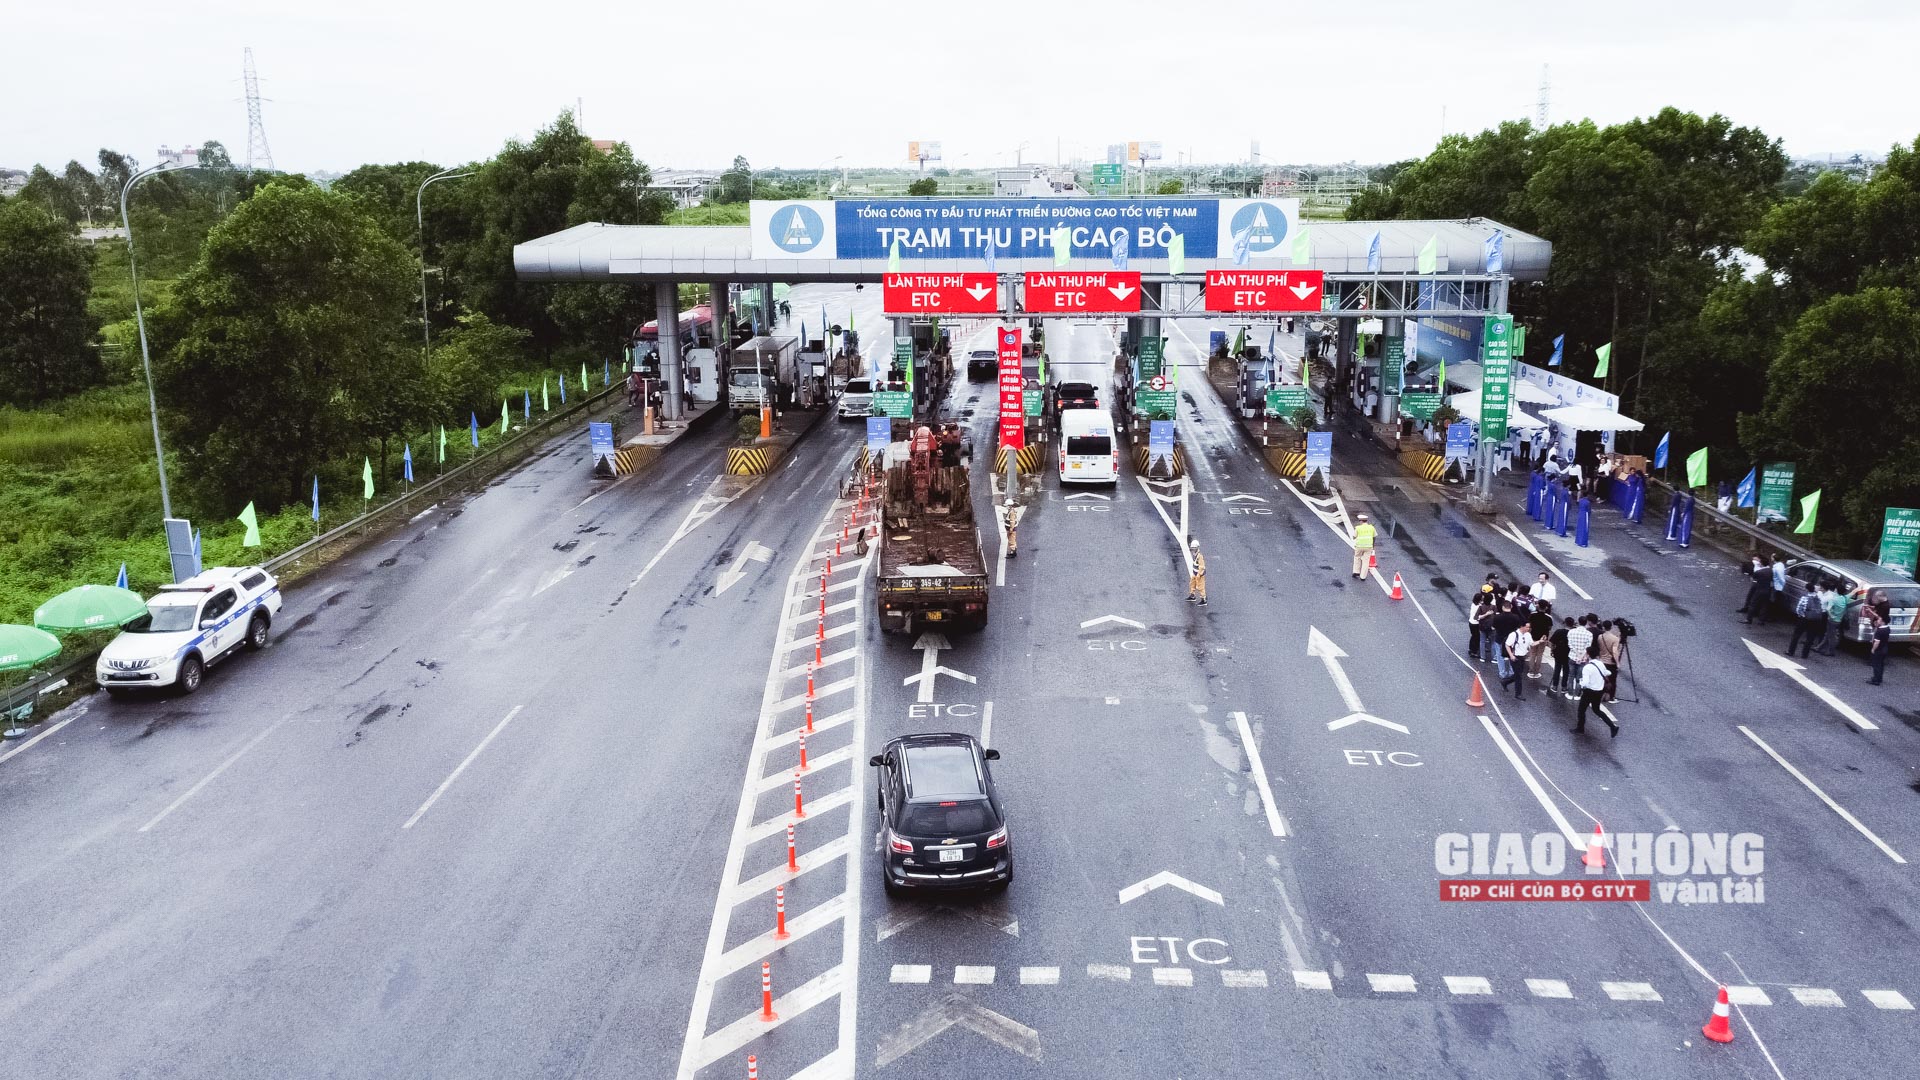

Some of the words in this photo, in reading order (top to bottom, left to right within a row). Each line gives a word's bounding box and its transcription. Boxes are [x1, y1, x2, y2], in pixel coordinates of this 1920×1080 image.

[857, 204, 887, 218] TỔNG
[890, 207, 922, 218] CÔNG
[925, 208, 938, 218] TY
[941, 205, 964, 218] ĐẦU
[967, 208, 982, 218] TƯ
[984, 206, 1013, 218] PHÁT
[1016, 204, 1049, 218] TRIỂN
[1052, 205, 1091, 218] ĐƯỜNG
[1094, 208, 1117, 218] CAO
[1120, 205, 1143, 218] TỐC
[1145, 207, 1170, 219] VIỆT
[1173, 208, 1197, 218] NAM
[877, 228, 950, 253] TRẠM
[959, 227, 1012, 248] THU
[888, 273, 914, 288] LÀN
[916, 276, 940, 288] THU
[943, 273, 964, 288] PHÍ
[1030, 273, 1055, 288] LÀN
[1058, 276, 1083, 288] THU
[1085, 273, 1107, 288] PHÍ
[1210, 272, 1236, 286] LÀN
[1238, 275, 1264, 286] THU
[1266, 272, 1289, 286] PHÍ
[911, 292, 941, 307] ETC
[1054, 292, 1086, 306] ETC
[1234, 291, 1267, 306] ETC
[1228, 507, 1273, 515] ETC
[1902, 528, 1920, 537] VETC
[1087, 639, 1148, 651] ETC
[908, 703, 978, 718] ETC
[1342, 749, 1424, 767] ETC
[1130, 936, 1232, 964] ETC
